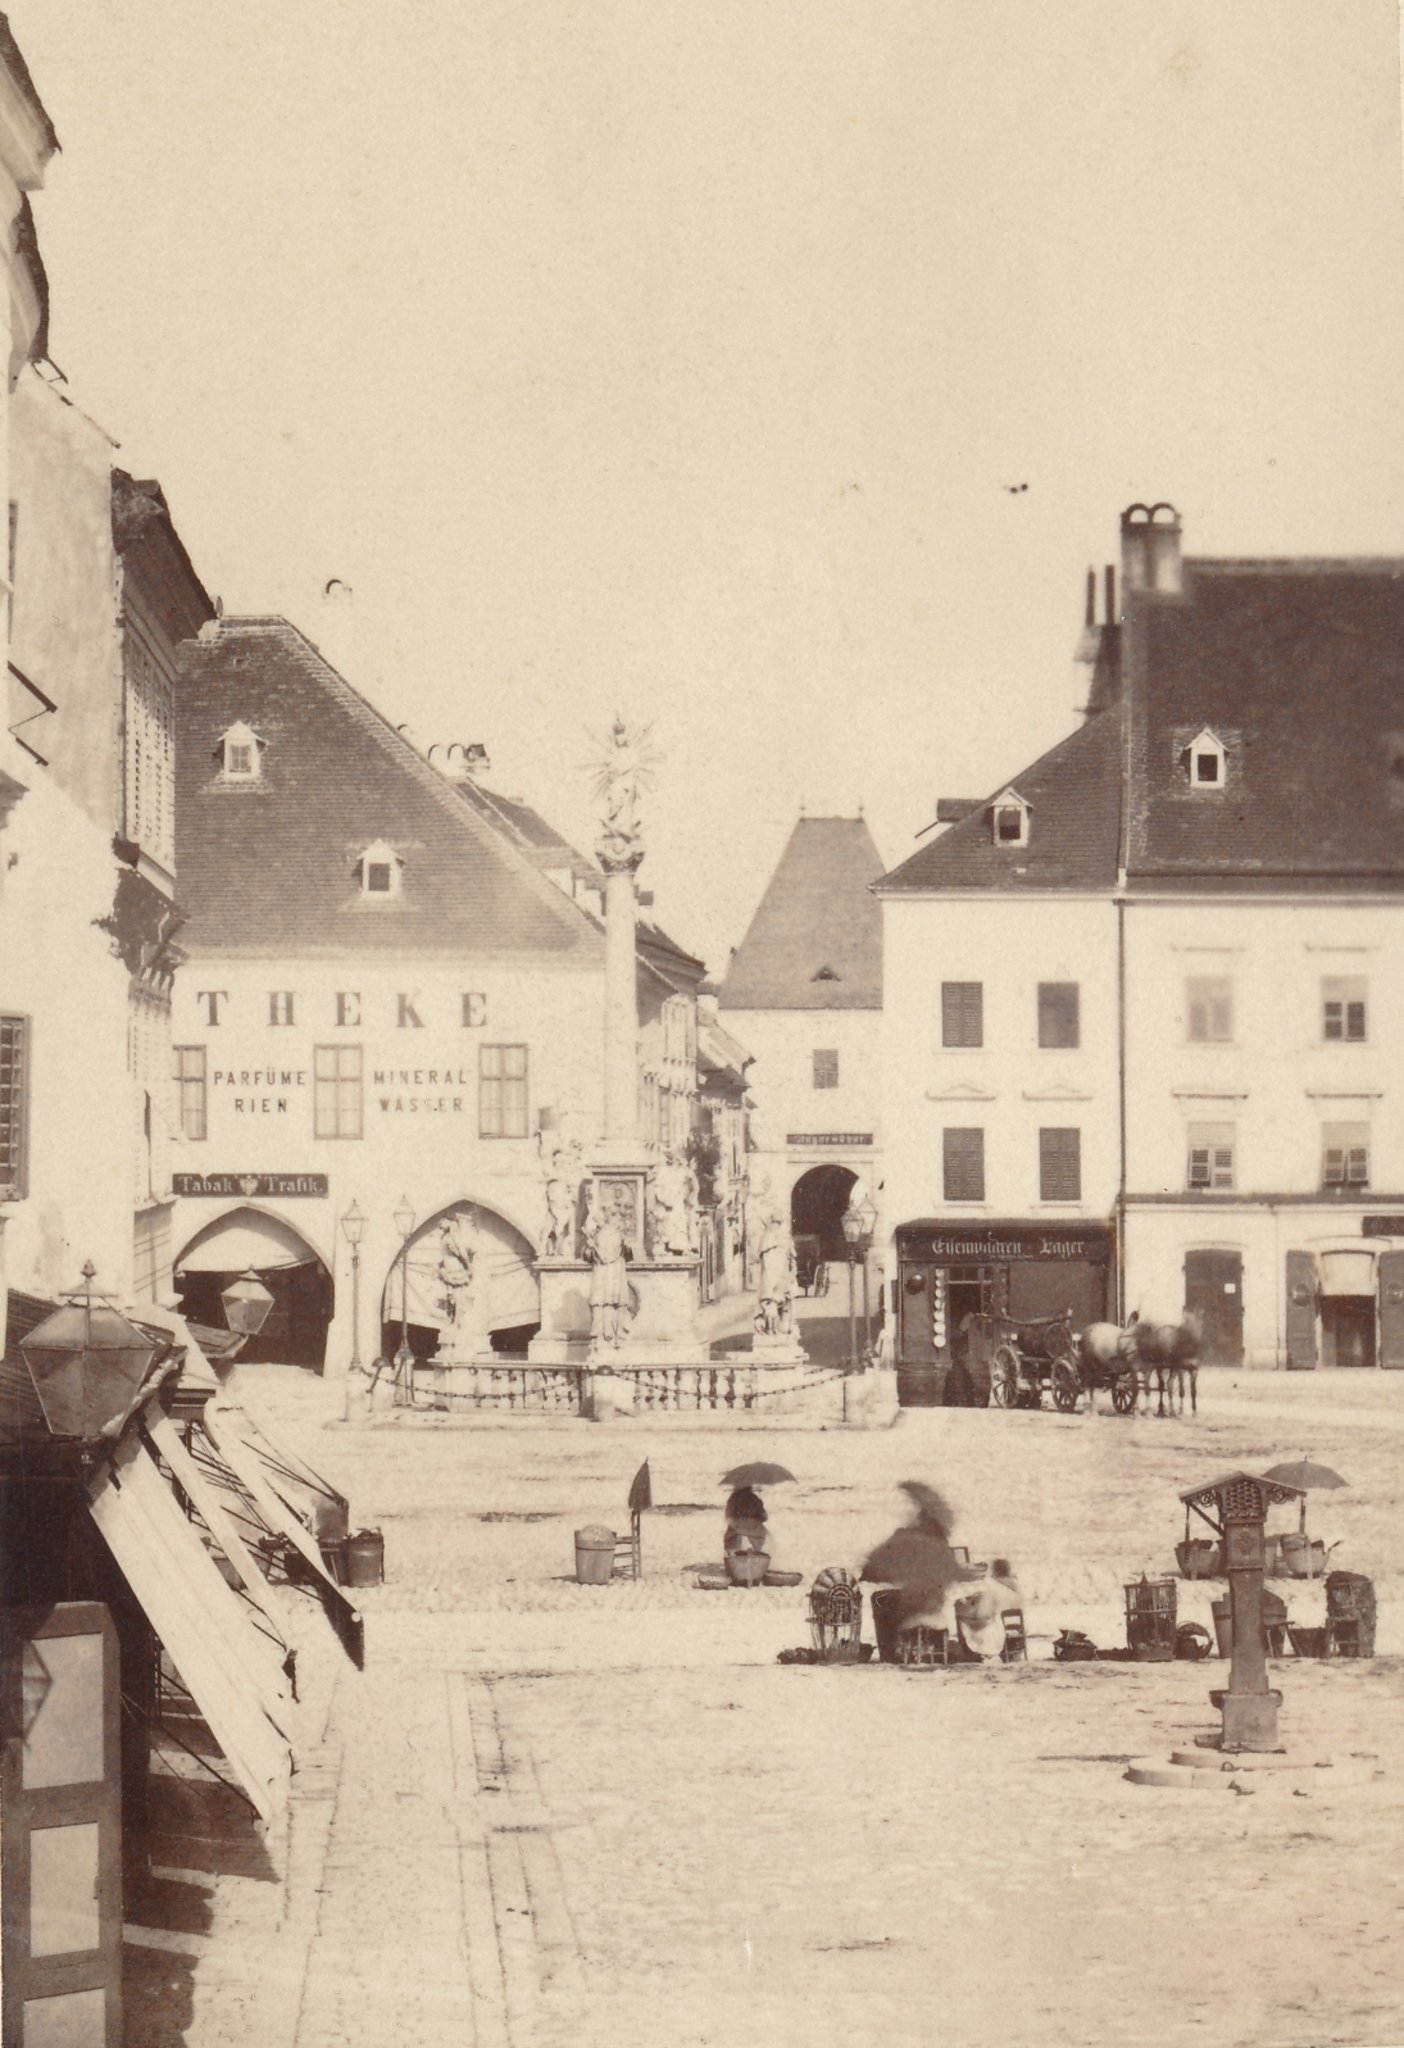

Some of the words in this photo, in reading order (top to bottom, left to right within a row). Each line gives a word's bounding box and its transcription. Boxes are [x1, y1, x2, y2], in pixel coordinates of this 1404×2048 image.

[197, 990, 488, 1028] THEKE
[213, 1067, 307, 1086] PARFÜME
[373, 1070, 467, 1085] MINERAL
[235, 1098, 288, 1113] RIEN
[379, 1097, 463, 1112] WASSER
[178, 1176, 234, 1192] Tabak
